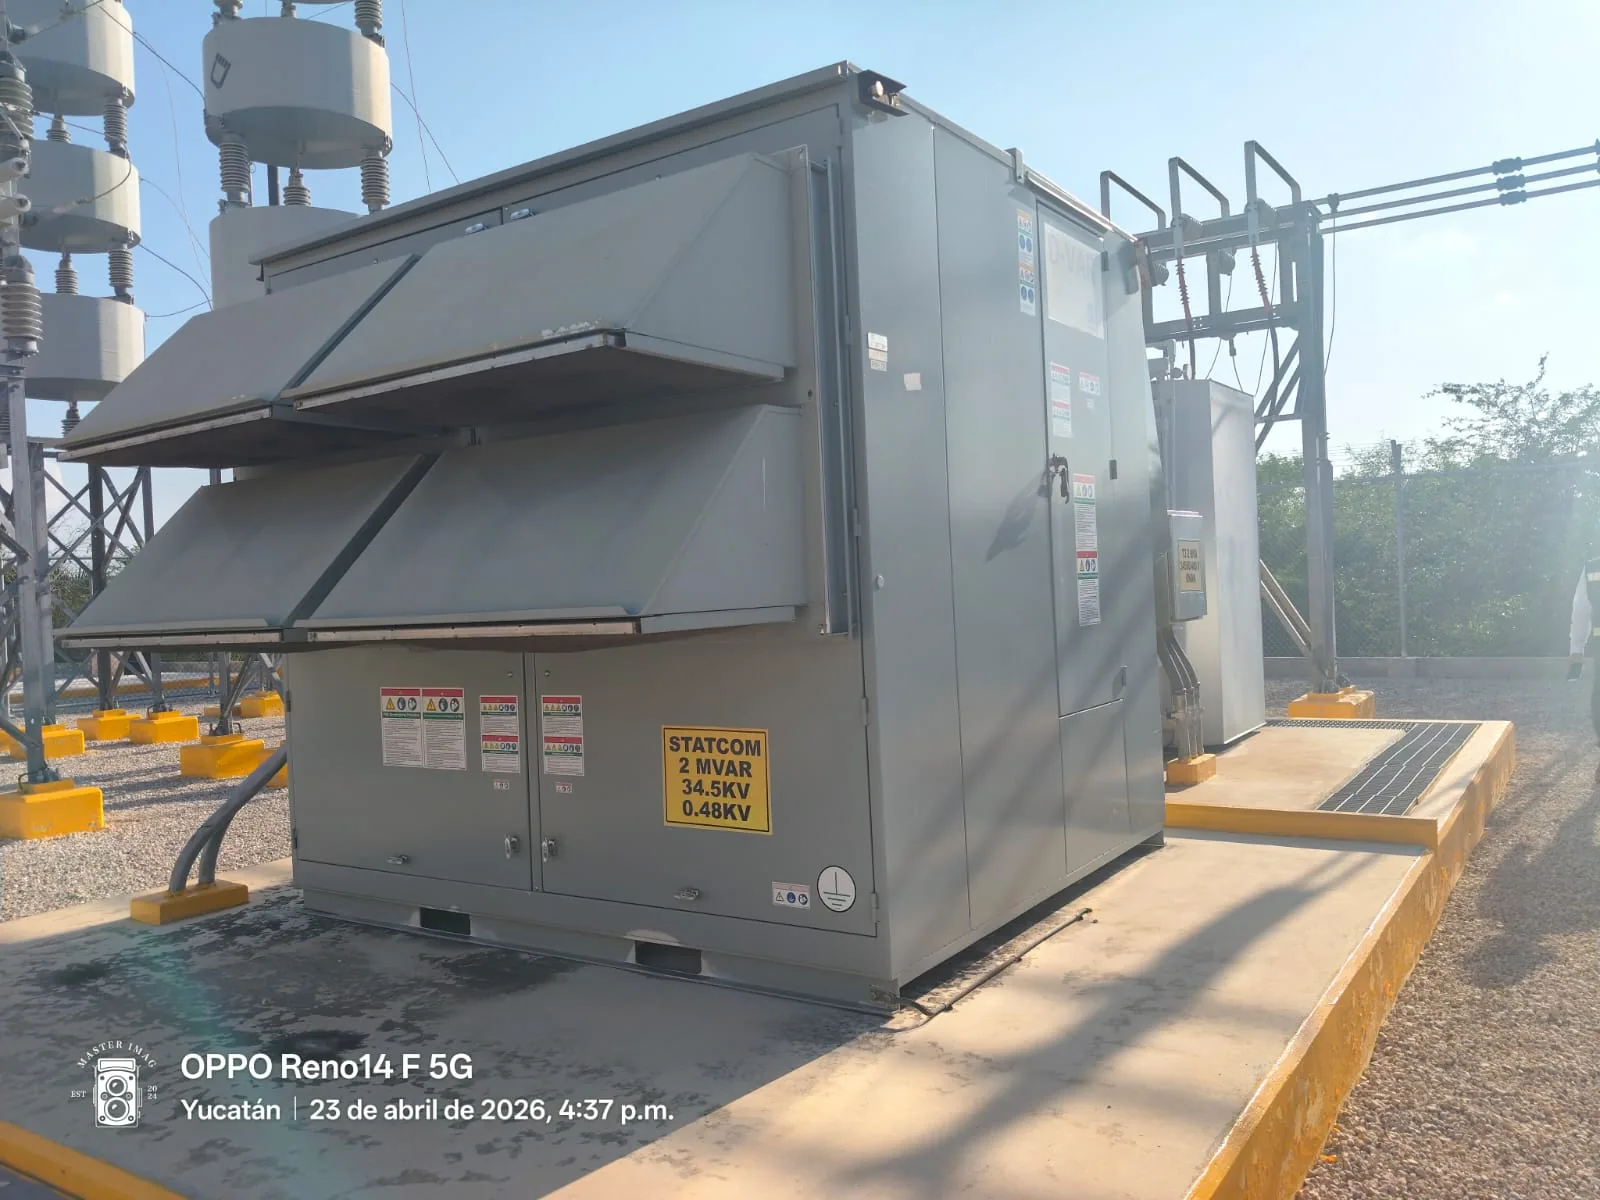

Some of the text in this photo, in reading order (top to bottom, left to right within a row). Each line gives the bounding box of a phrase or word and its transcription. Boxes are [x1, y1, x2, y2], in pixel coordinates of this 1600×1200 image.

[669, 736, 761, 757] STATCOM
[679, 757, 752, 778] 2 MVAR
[682, 779, 751, 800] 34.5KV
[682, 800, 752, 822] 0.48KV
